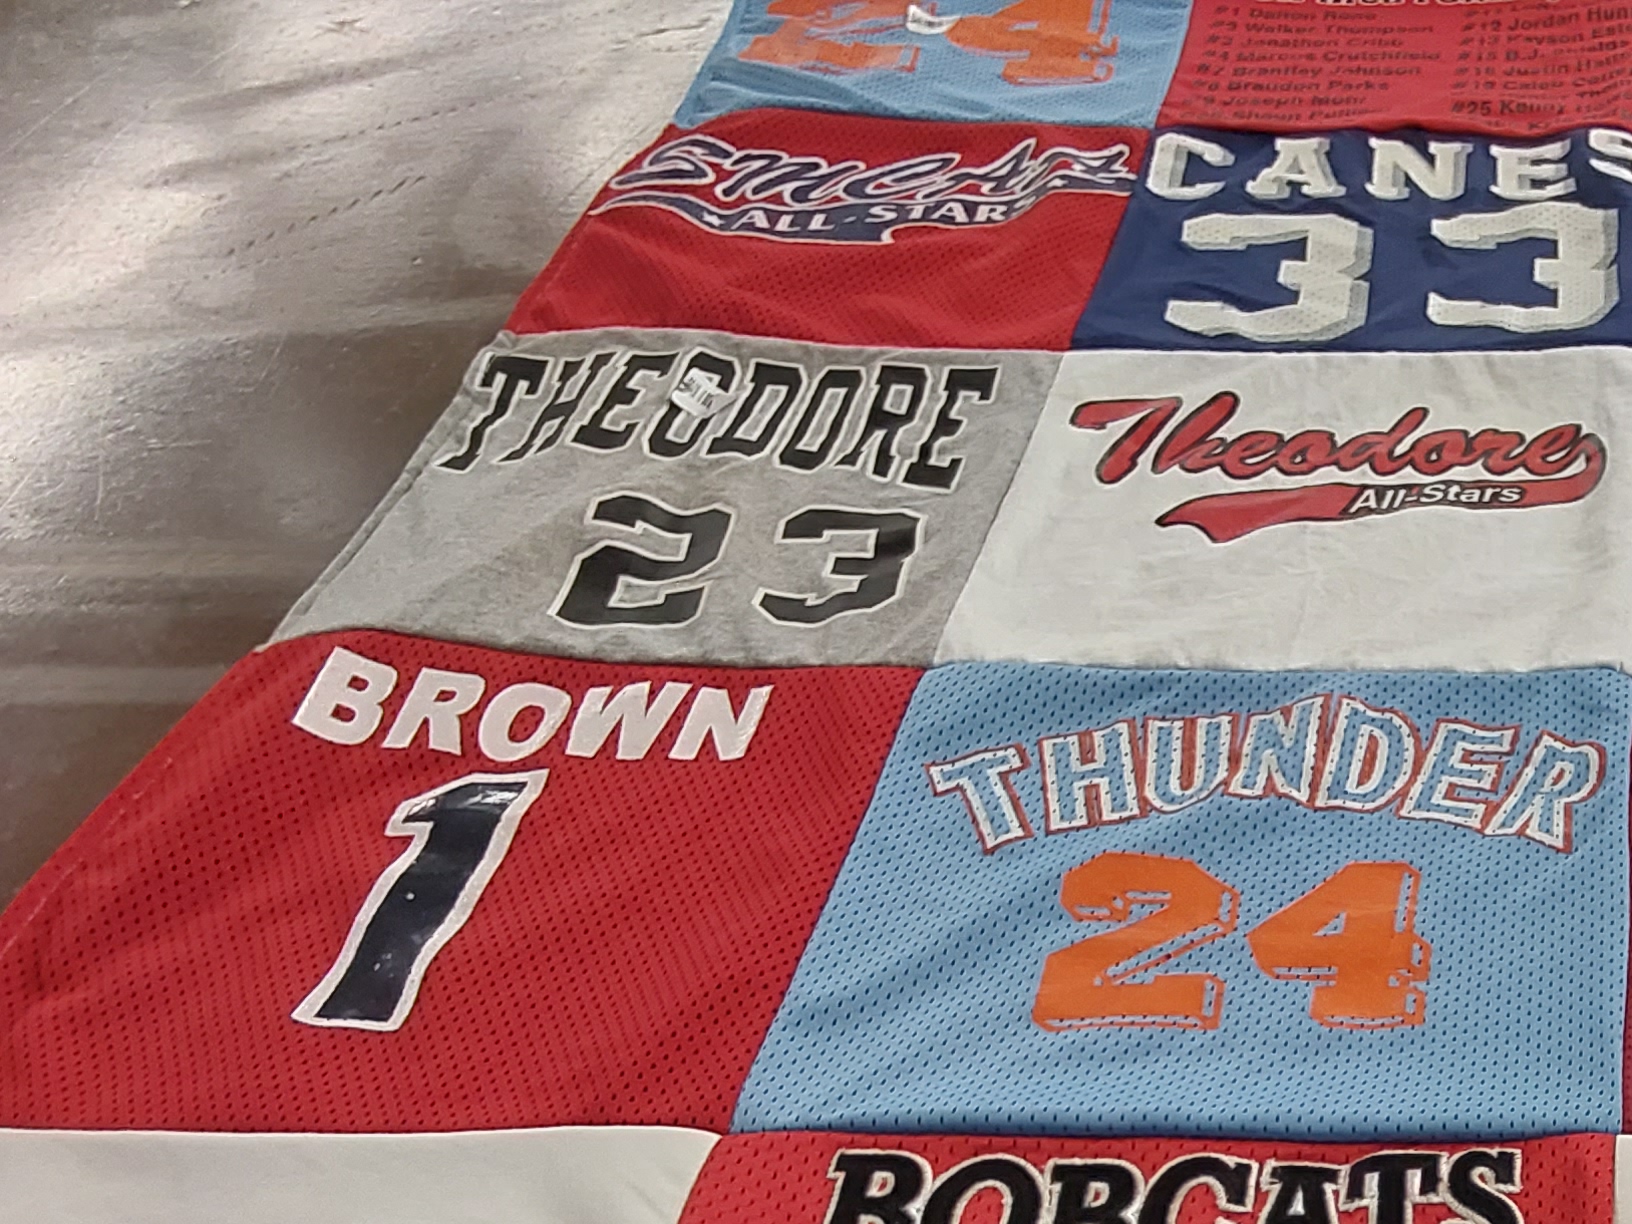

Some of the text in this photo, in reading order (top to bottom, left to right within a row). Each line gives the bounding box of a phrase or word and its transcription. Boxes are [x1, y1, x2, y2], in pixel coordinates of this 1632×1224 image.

[1507, 13, 1580, 31] Jordan
[1164, 202, 1621, 342] 33
[433, 347, 1001, 491] THEODORE
[1069, 390, 1606, 484] Theodore
[547, 491, 928, 630] 23
[1347, 482, 1524, 515] All-Stars
[291, 646, 774, 763] BROWN
[925, 693, 1607, 855] THUNDER
[291, 768, 549, 1032] 1
[1031, 851, 1433, 1033] 24
